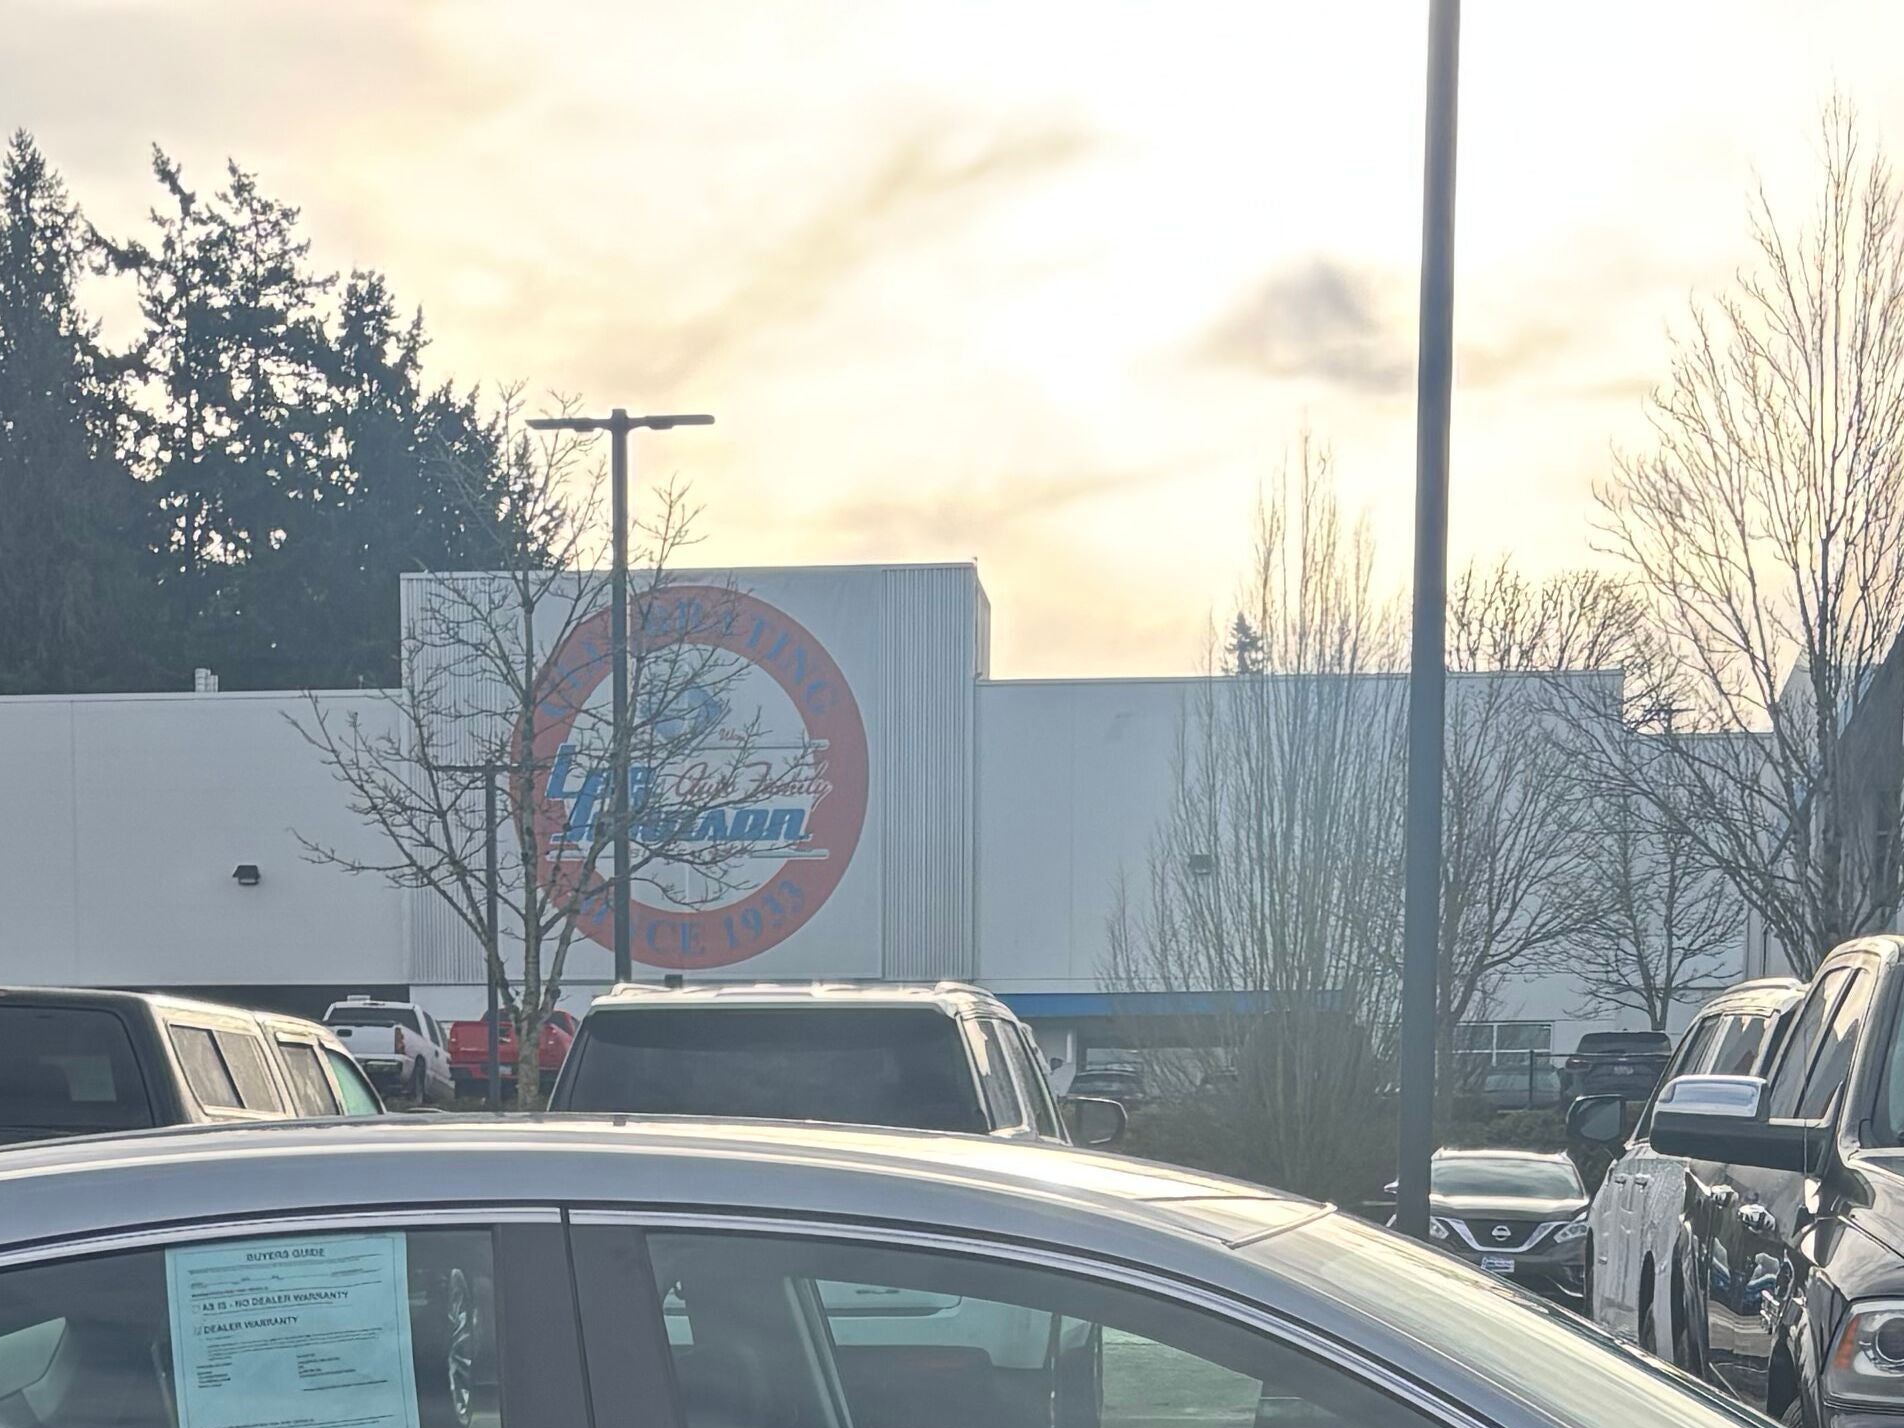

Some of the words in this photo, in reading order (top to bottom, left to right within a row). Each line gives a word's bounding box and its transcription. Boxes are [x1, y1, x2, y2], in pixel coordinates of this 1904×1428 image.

[722, 879, 807, 950] 1933
[246, 1250, 289, 1262] BUYERS
[292, 1248, 326, 1259] GUIDE
[252, 1294, 291, 1307] DEALER
[293, 1291, 349, 1303] WARRANTY
[203, 1321, 245, 1335] DEALER
[245, 1316, 299, 1329] WARRANTY
